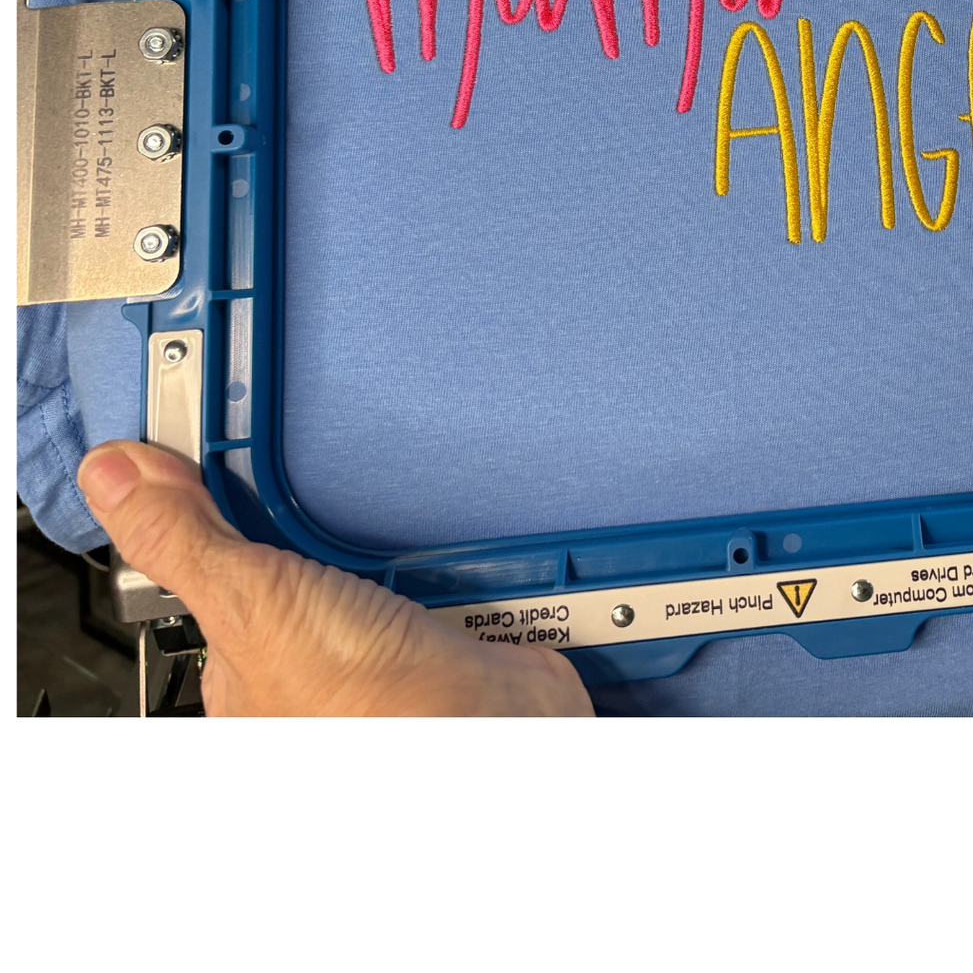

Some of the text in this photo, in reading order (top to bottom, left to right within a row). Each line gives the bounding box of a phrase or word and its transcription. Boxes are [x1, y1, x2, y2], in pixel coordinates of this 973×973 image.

[70, 49, 93, 239] MH-MT400-1010-BKT-L
[95, 49, 117, 238] MH-MT475-1113-BKT-L
[911, 566, 958, 582] Drives
[665, 593, 773, 620] Pinch Hazard
[873, 586, 948, 607] Computer
[464, 605, 570, 631] Credit Cards
[526, 626, 570, 644] Keep
